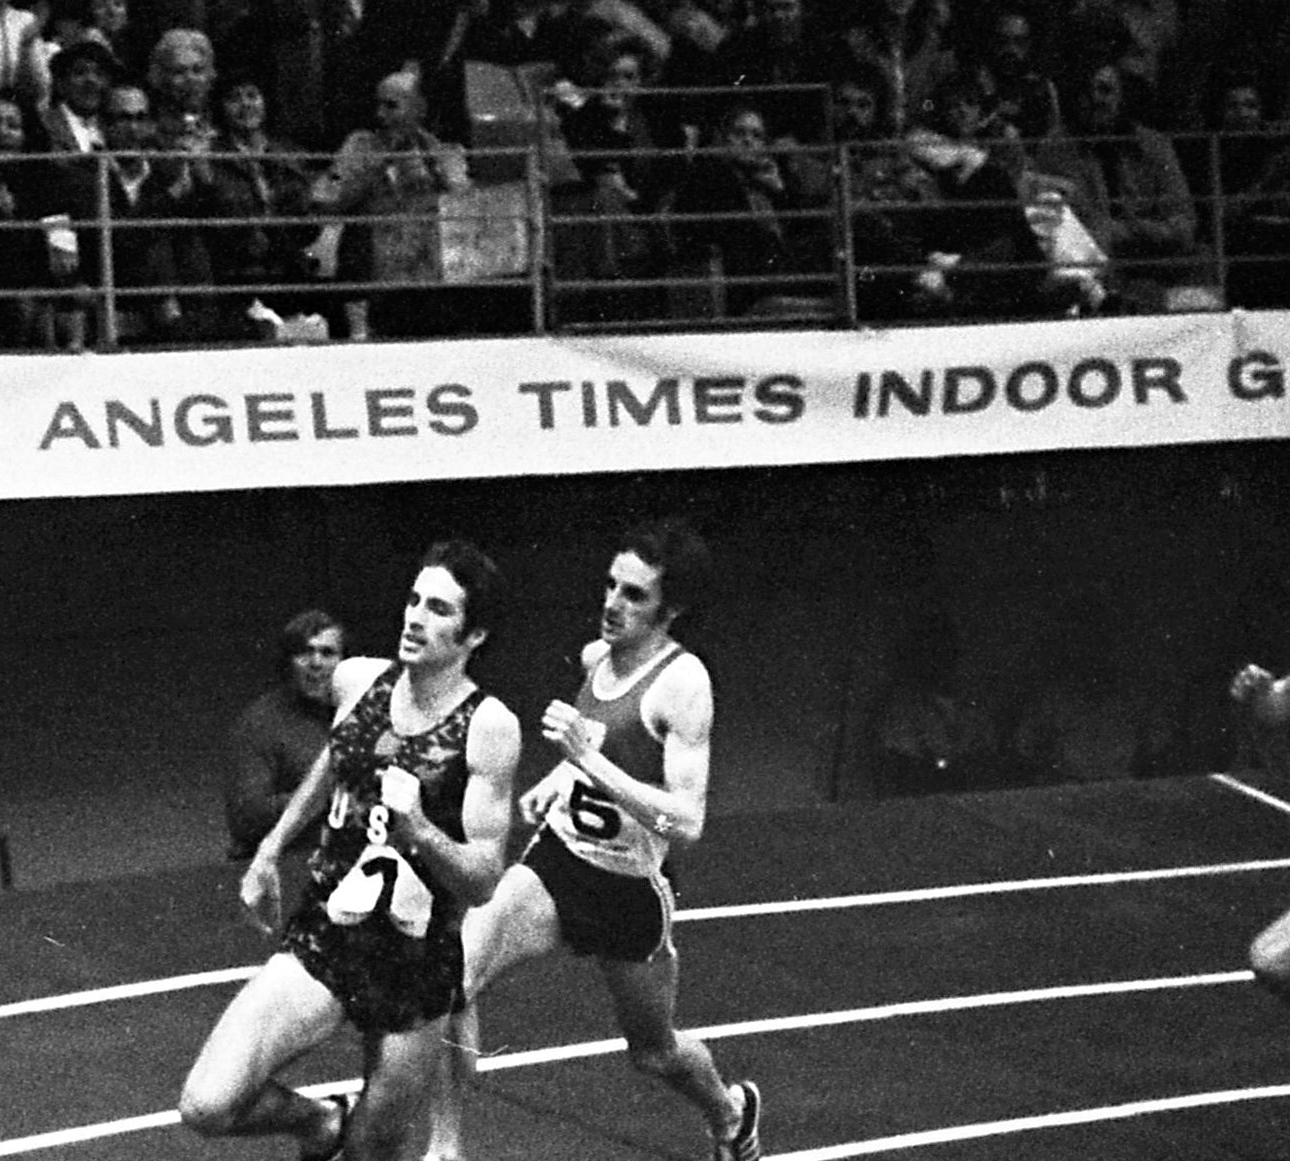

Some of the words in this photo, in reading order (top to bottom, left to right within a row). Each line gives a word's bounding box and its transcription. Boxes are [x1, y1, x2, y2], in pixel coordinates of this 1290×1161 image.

[37, 383, 480, 450] ANGELES
[518, 373, 806, 429] TIMES
[853, 356, 1189, 418] INDOOR
[1227, 351, 1286, 401] G
[570, 779, 623, 841] 6
[360, 856, 400, 917] 7
